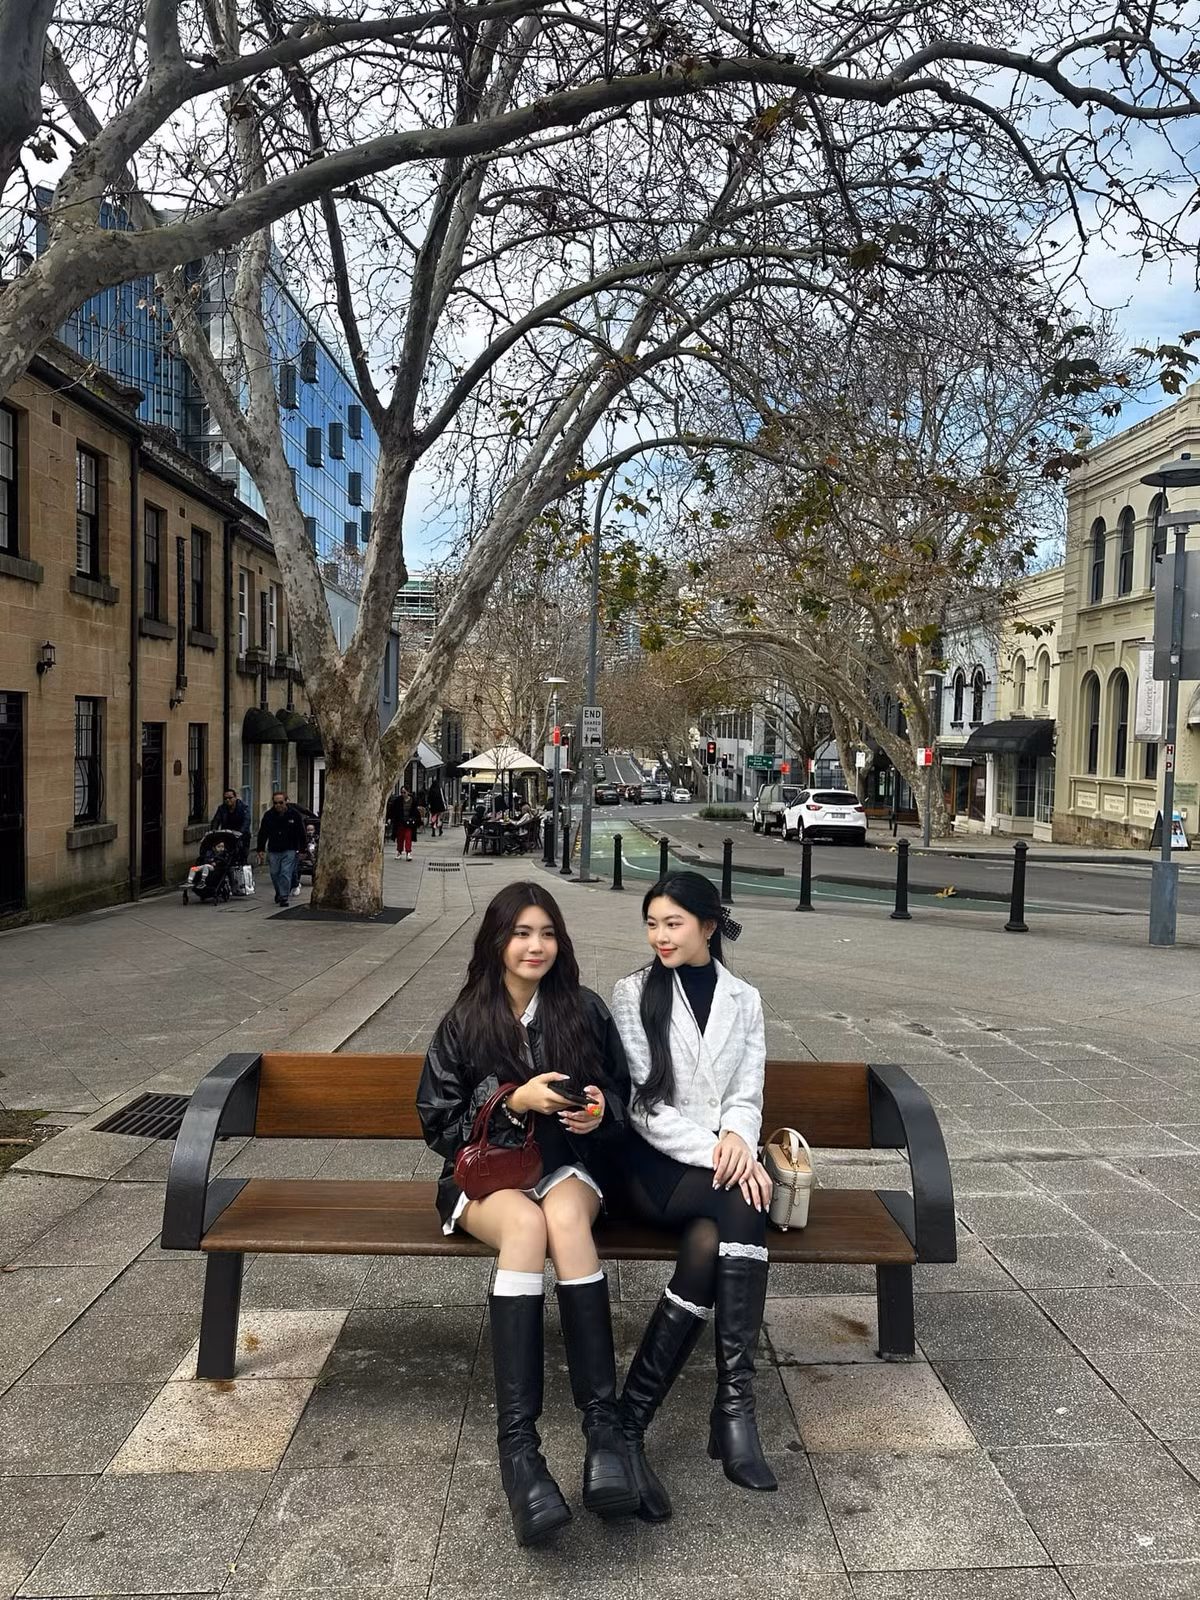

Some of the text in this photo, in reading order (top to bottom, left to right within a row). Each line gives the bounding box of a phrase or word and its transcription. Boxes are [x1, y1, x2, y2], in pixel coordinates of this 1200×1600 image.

[1144, 654, 1153, 732] Star Cosmetic Medicine
[584, 710, 600, 718] END
[1166, 746, 1173, 770] H P
